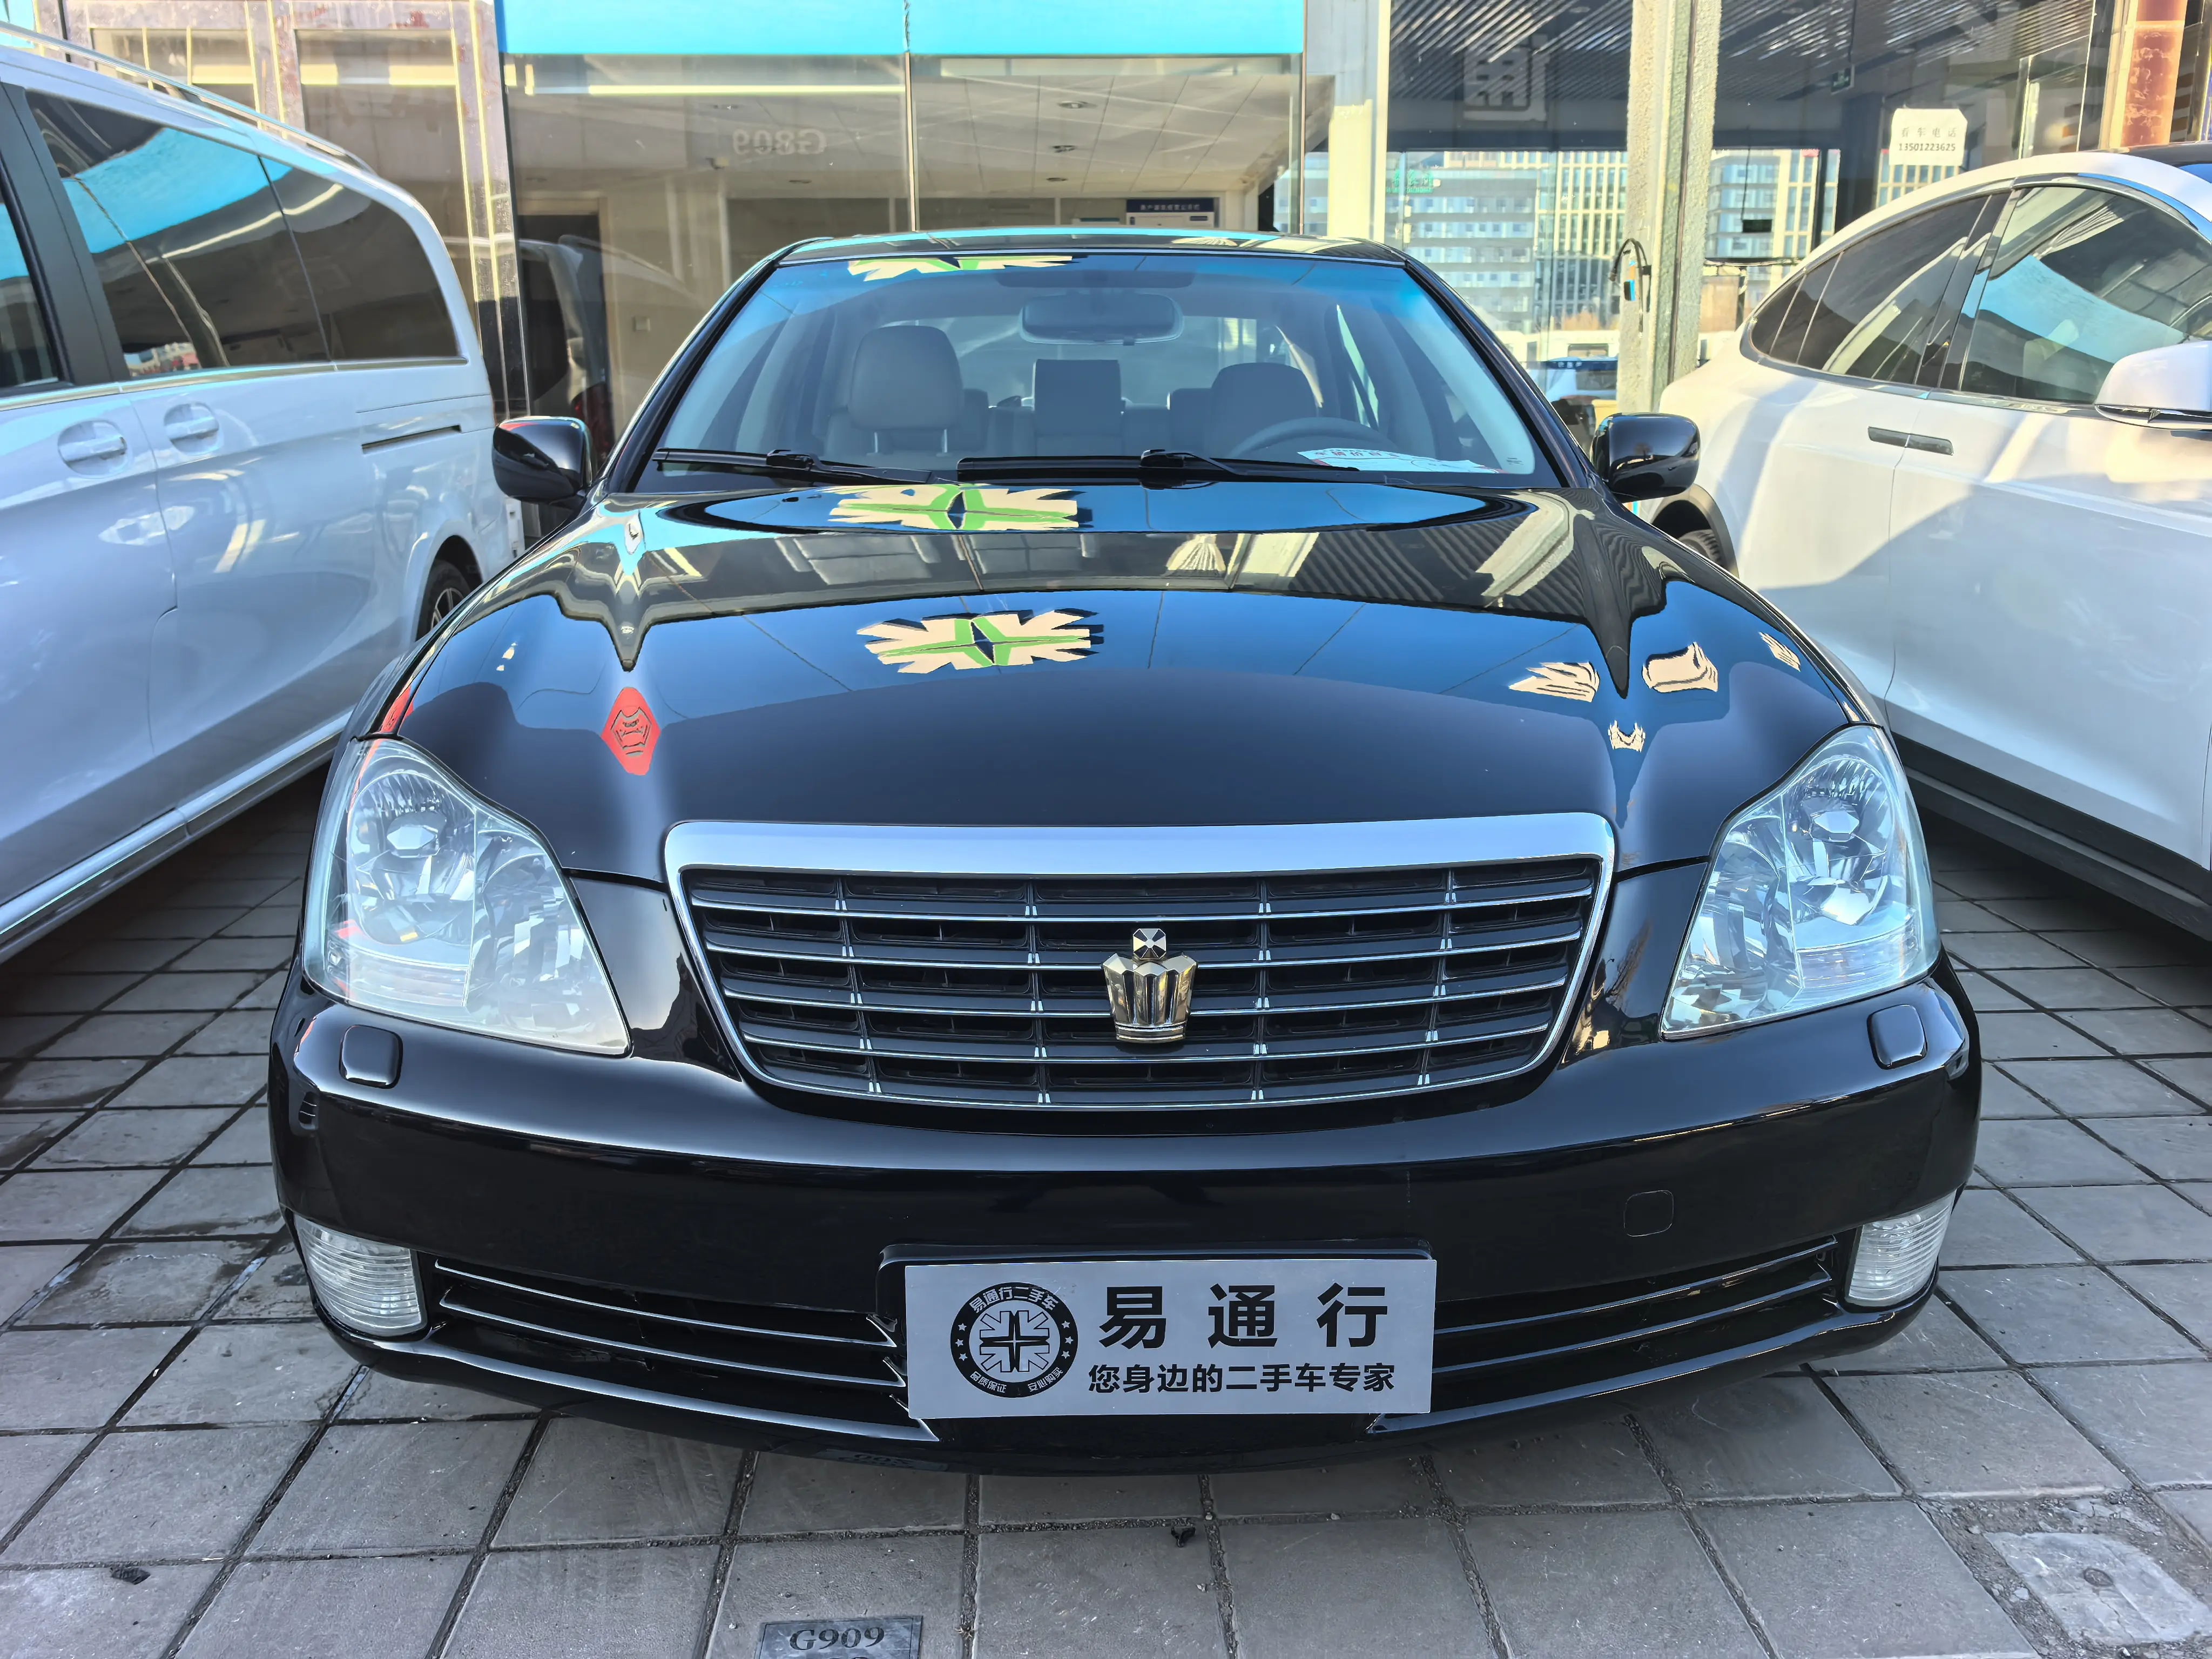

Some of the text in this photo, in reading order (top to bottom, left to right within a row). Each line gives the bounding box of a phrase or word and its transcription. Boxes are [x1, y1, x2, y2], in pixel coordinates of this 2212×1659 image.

[969, 1286, 1059, 1313] 易通行二手车
[1098, 1282, 1388, 1350] 易通行
[970, 1371, 1007, 1393] 品质保证
[1027, 1367, 1063, 1392] 安心购买
[1088, 1363, 1395, 1393] 您身边的二手车专家
[789, 1627, 885, 1650] G909
